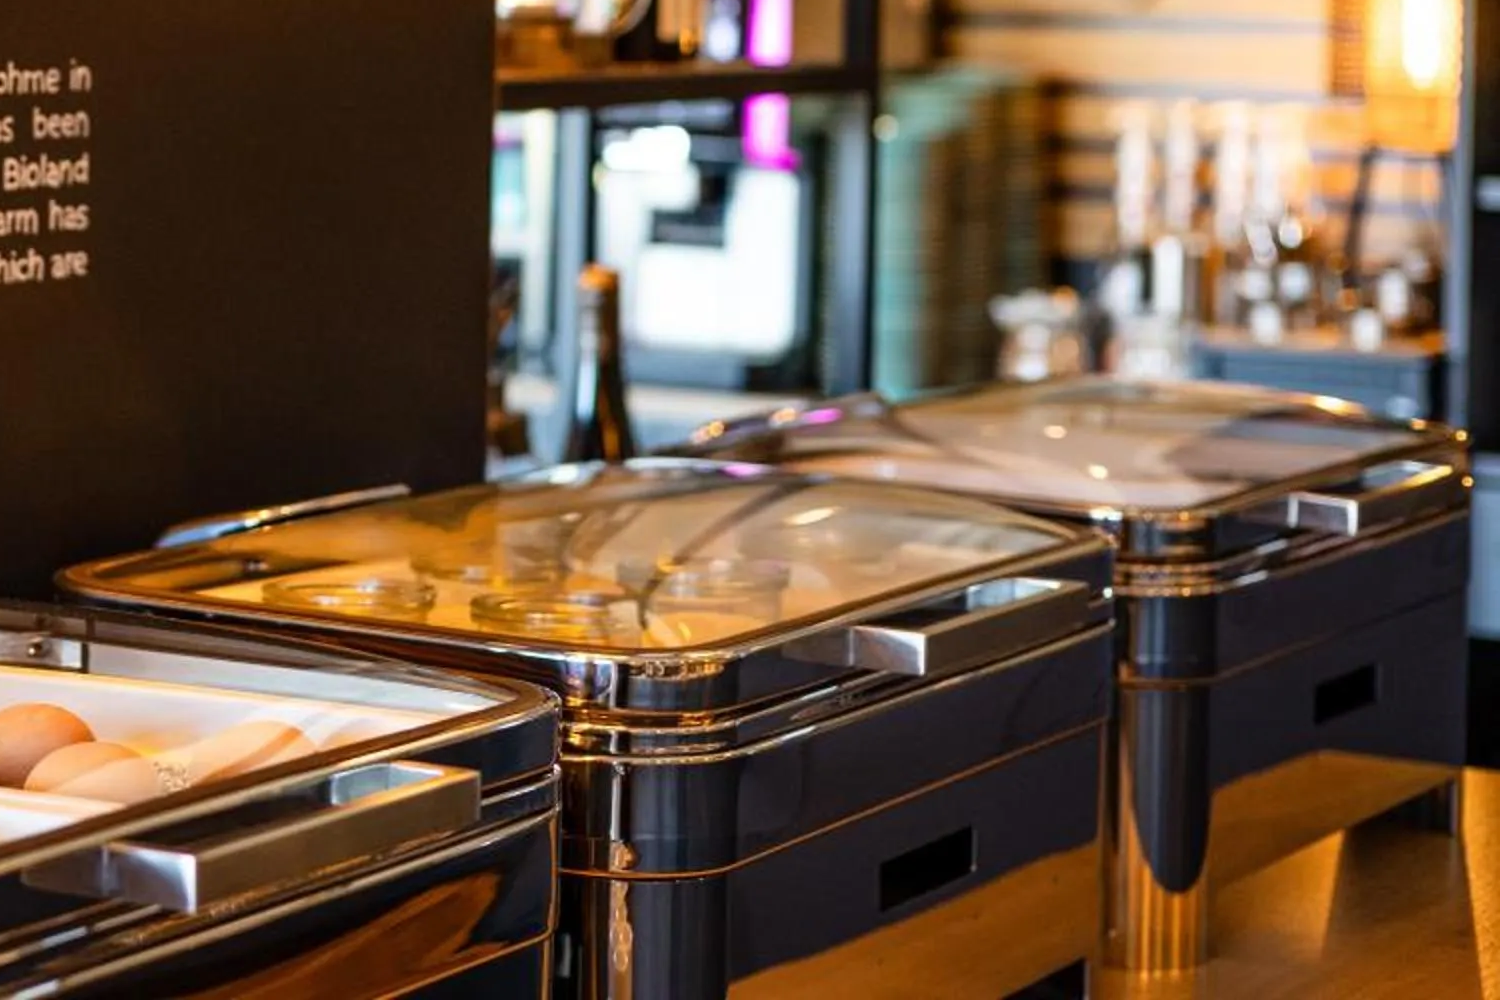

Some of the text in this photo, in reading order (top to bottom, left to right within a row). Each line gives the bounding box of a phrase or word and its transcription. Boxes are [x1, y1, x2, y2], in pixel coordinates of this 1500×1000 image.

[69, 58, 92, 91] in
[32, 107, 90, 139] been
[3, 152, 89, 191] Bioland
[48, 199, 89, 230] has
[50, 251, 88, 279] are
